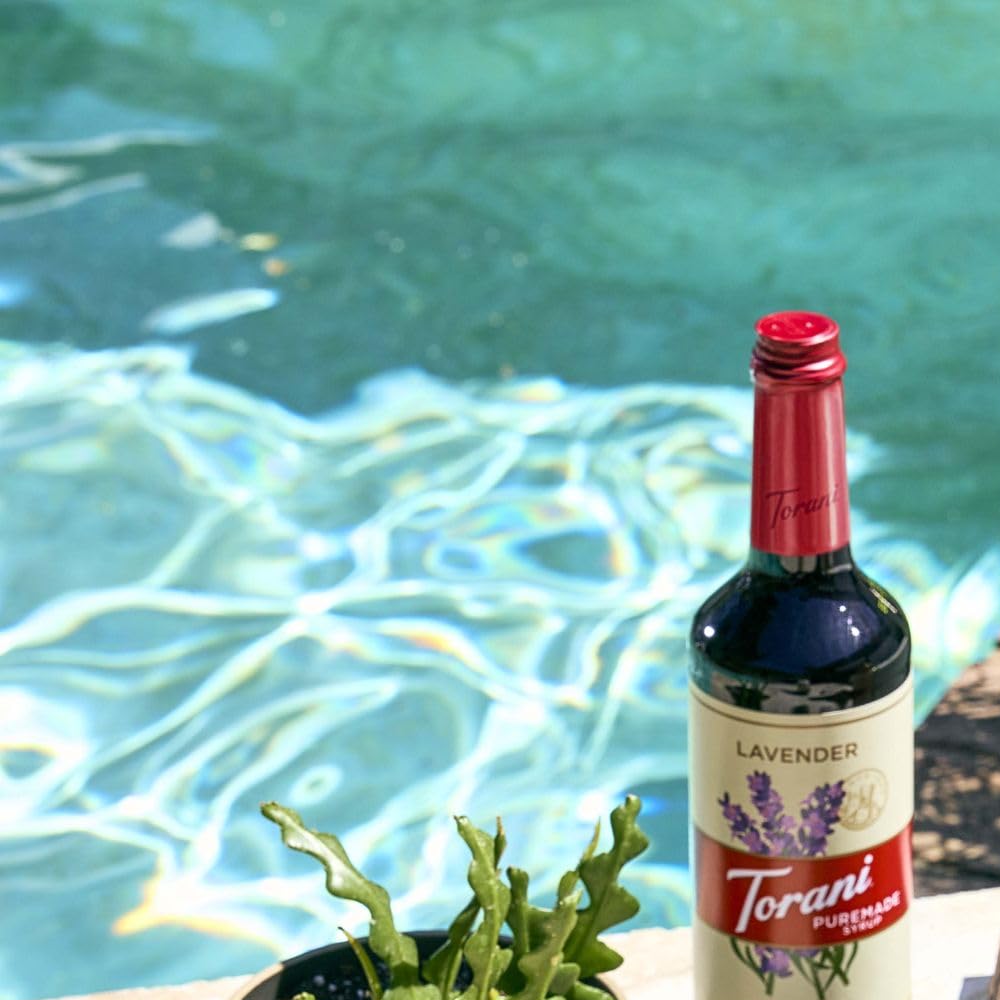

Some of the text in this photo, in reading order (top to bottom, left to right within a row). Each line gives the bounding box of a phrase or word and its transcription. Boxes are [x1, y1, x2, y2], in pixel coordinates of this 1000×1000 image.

[764, 484, 839, 529] Torani
[736, 740, 858, 764] LAVENDER
[726, 854, 874, 933] Torani
[812, 890, 901, 929] PUREMADE
